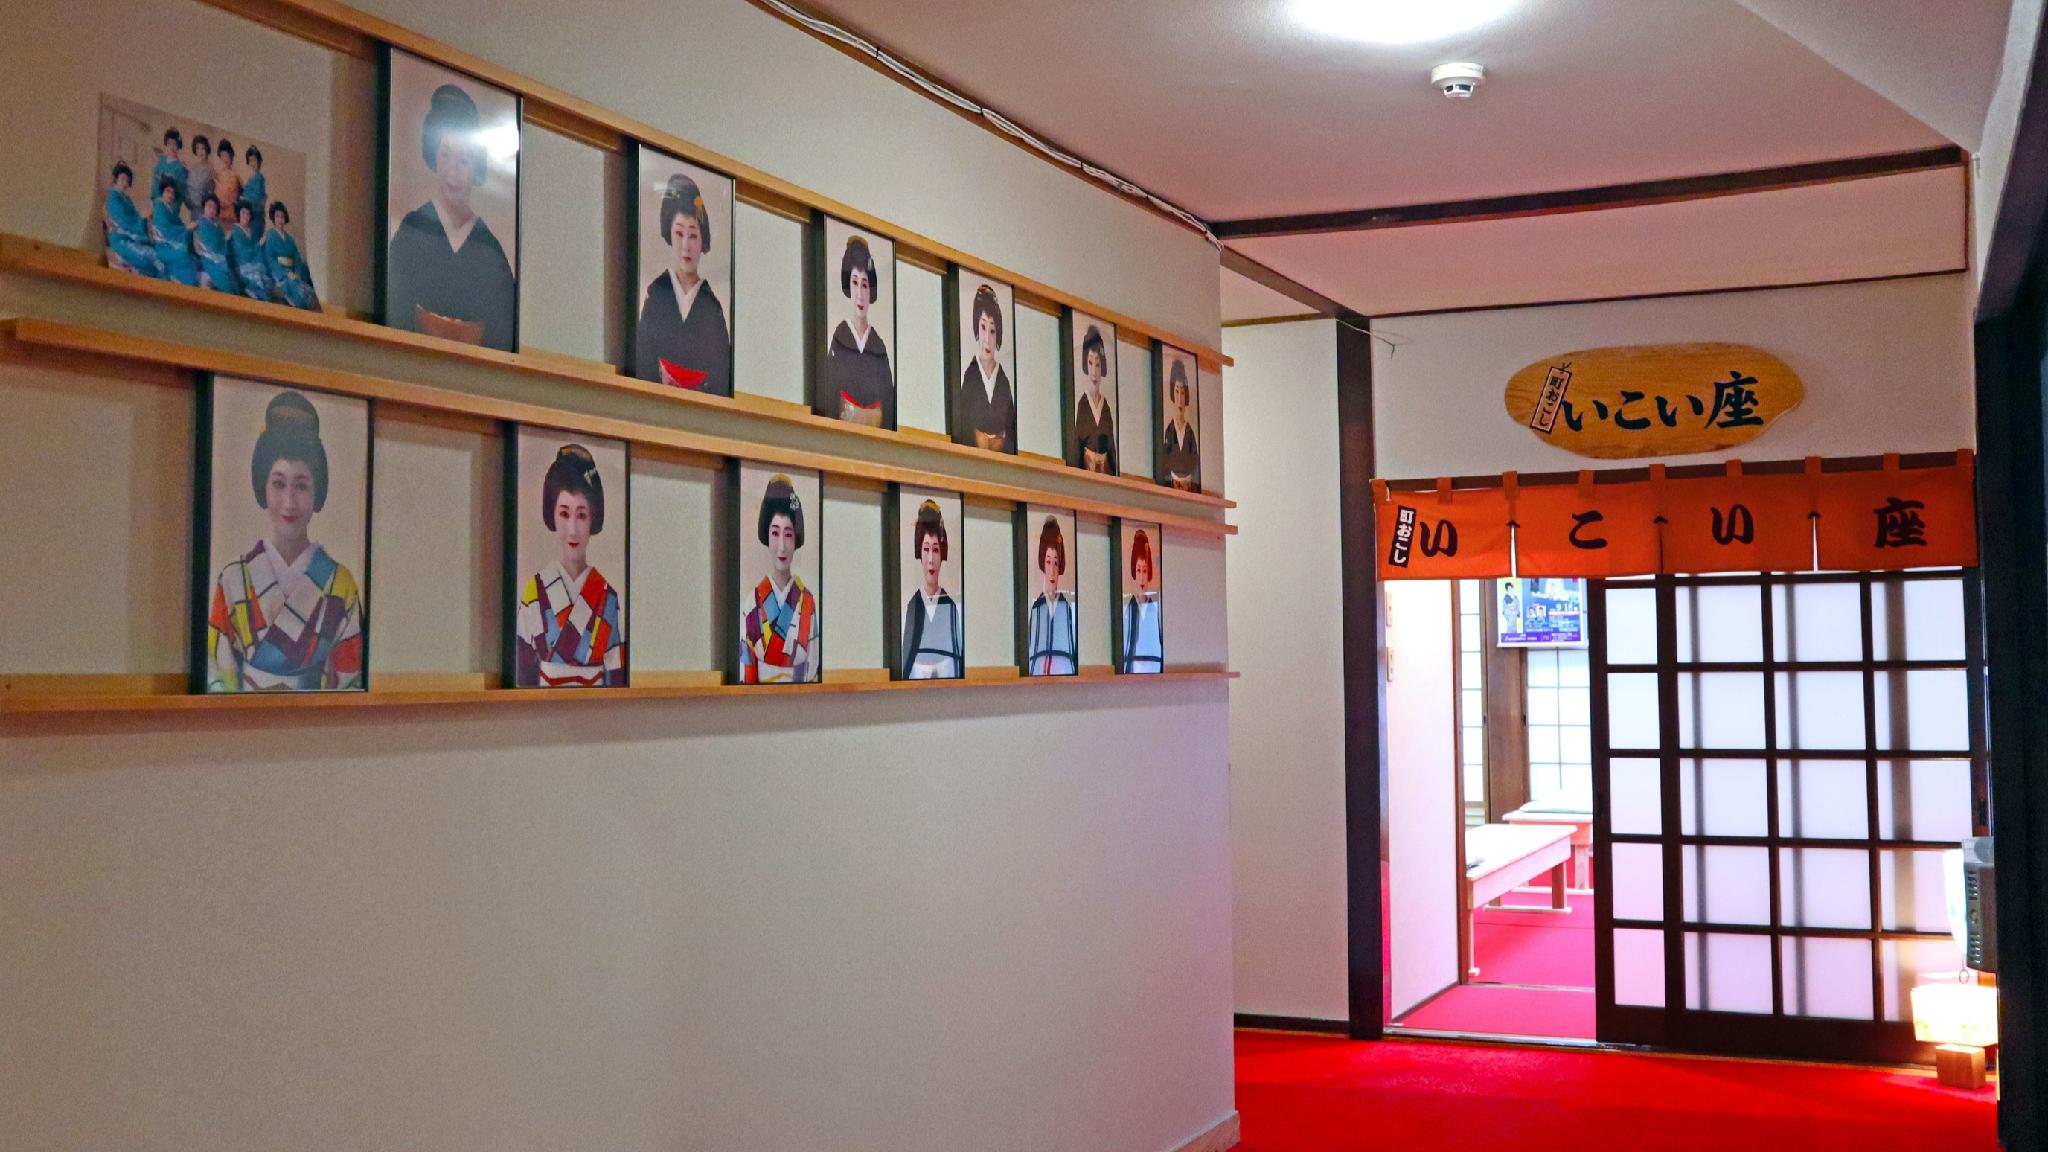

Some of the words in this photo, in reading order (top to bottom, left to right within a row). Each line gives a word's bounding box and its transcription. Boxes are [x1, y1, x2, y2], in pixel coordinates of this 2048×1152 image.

[1540, 375, 1564, 426] 町おこし
[1562, 370, 1764, 433] いこい座
[1393, 508, 1415, 564] 町おこし
